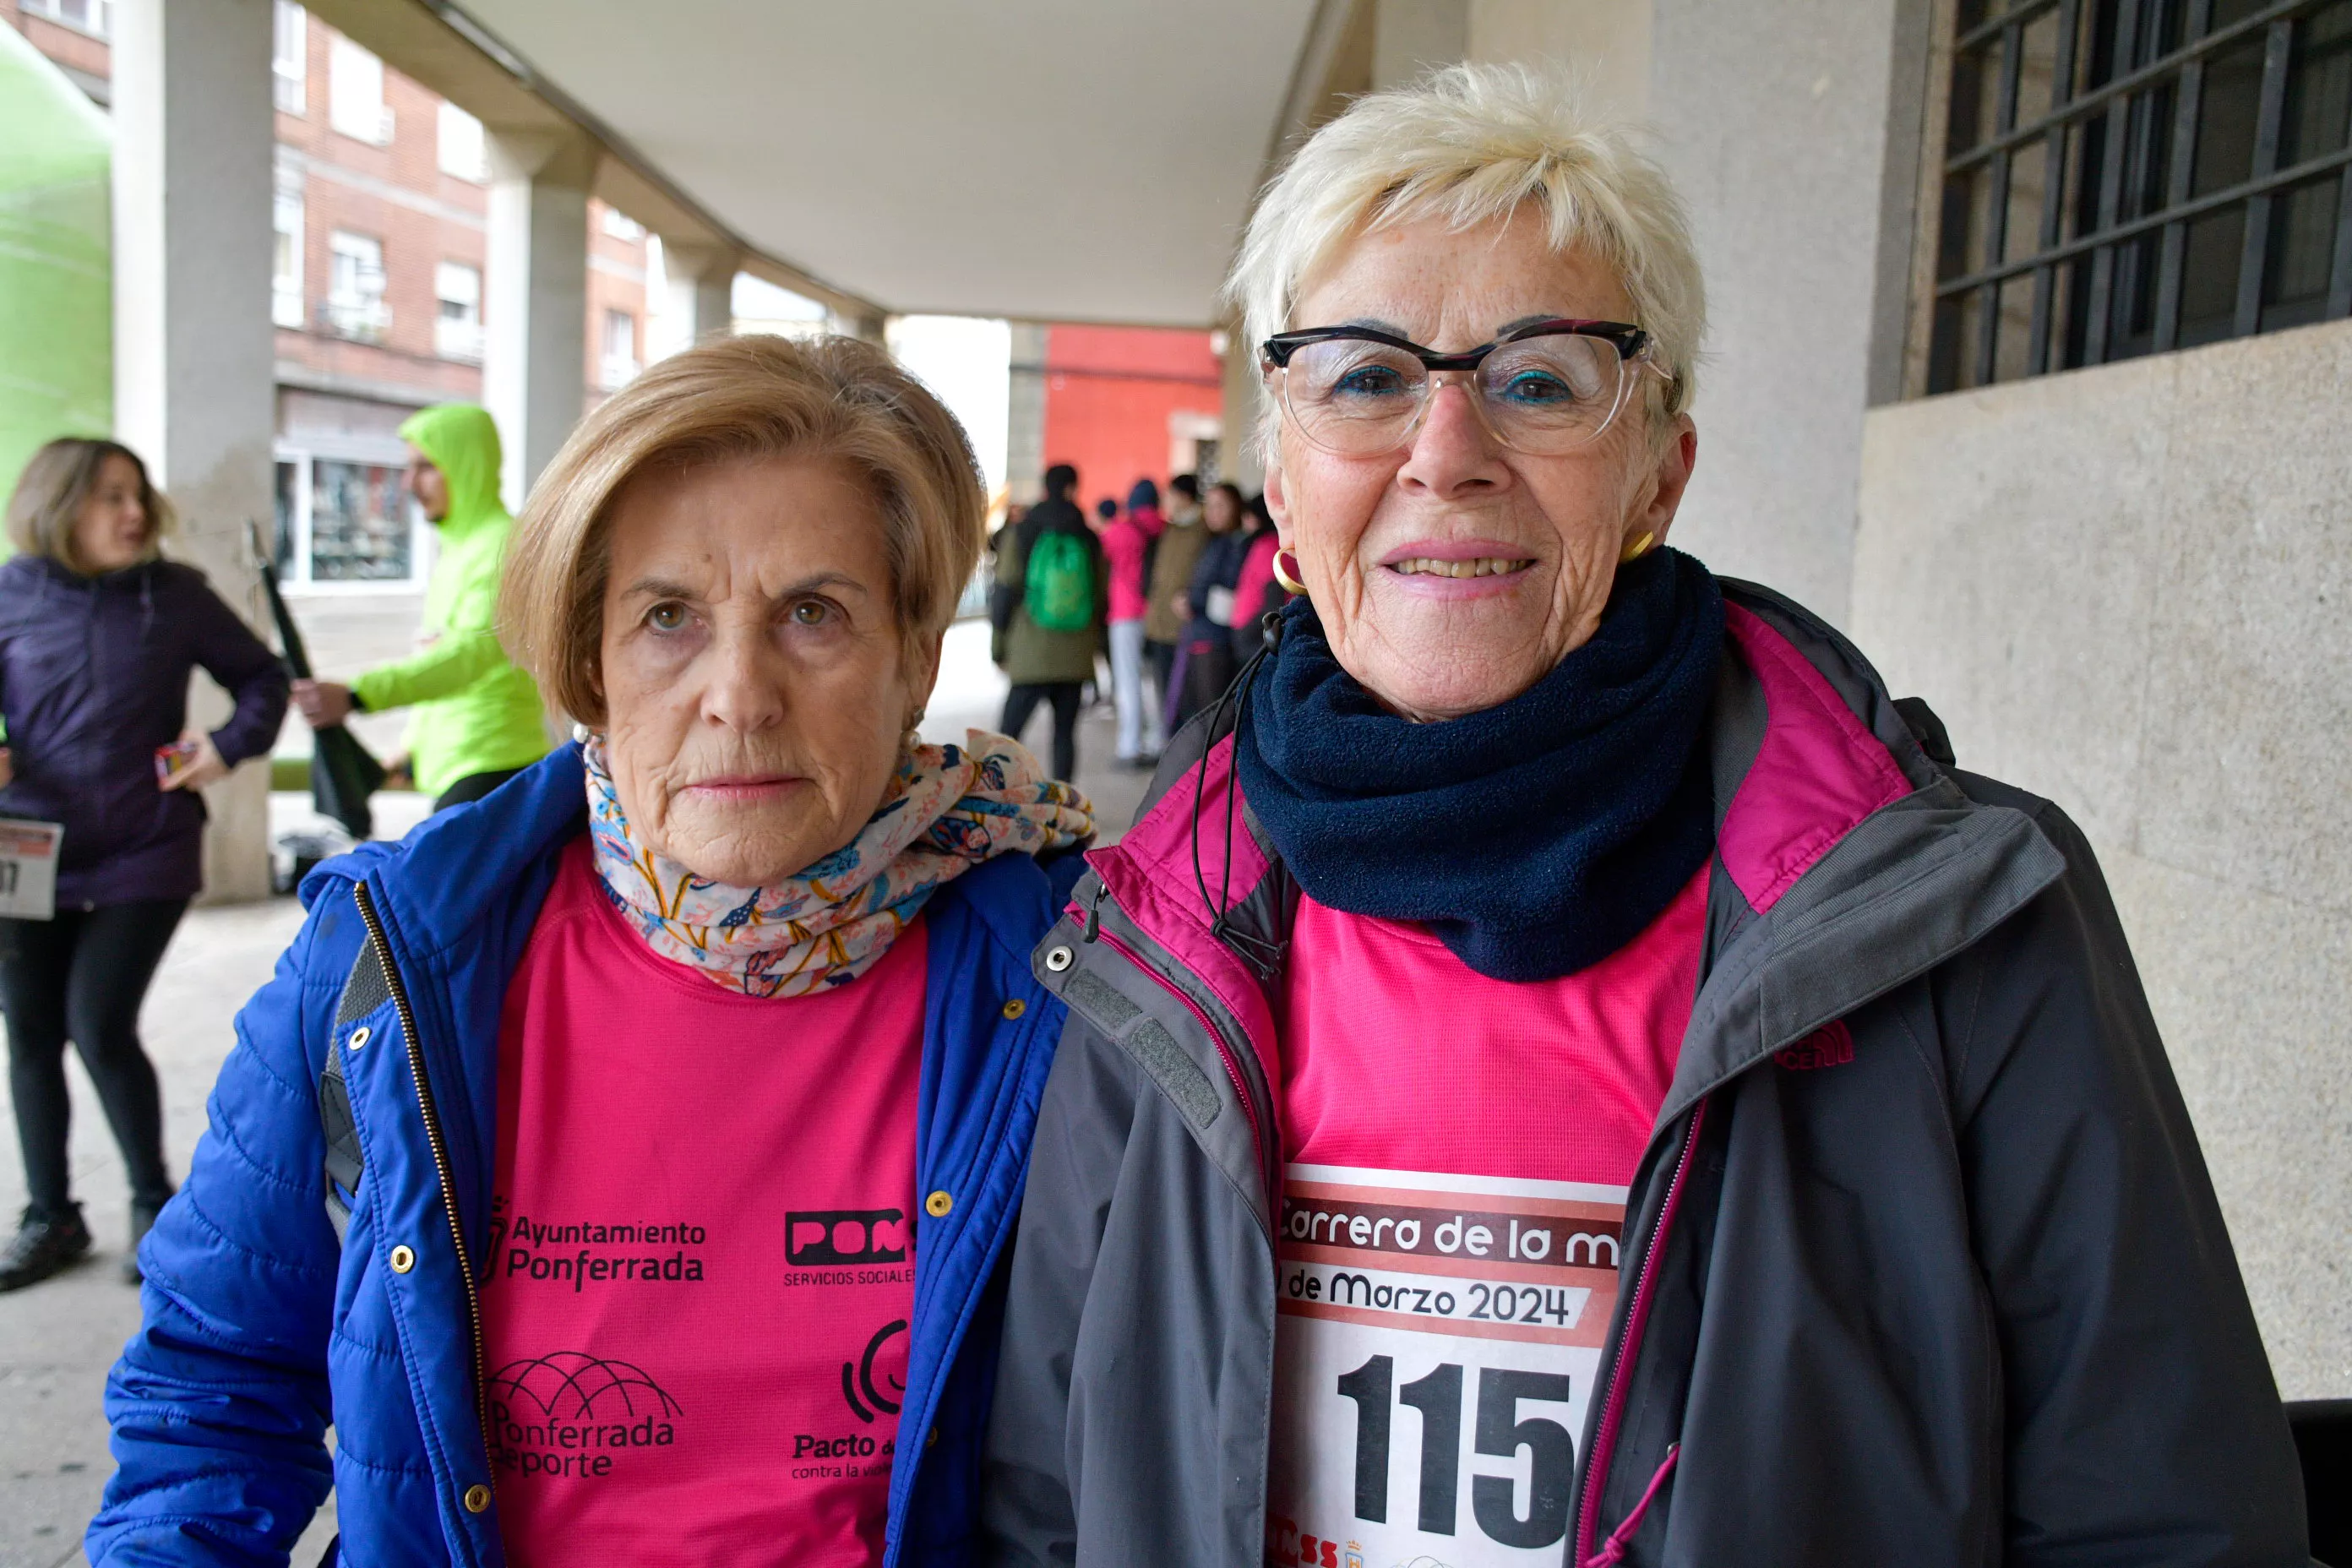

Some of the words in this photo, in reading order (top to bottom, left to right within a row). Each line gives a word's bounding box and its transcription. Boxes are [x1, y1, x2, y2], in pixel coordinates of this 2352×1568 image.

[513, 1216, 706, 1249] Ayuntamiento
[1435, 1215, 1494, 1255] de
[1509, 1219, 1550, 1260] la
[508, 1249, 704, 1293] Ponferrada
[784, 1271, 854, 1286] SERVICIOS
[1288, 1269, 1321, 1300] de
[1330, 1272, 1456, 1315] Marzo
[1467, 1282, 1569, 1326] 2024
[493, 1400, 674, 1450] Ponferrada
[792, 1433, 876, 1458] Pacto
[792, 1465, 841, 1479] contra
[847, 1462, 859, 1478] la
[1337, 1353, 1575, 1549] 115
